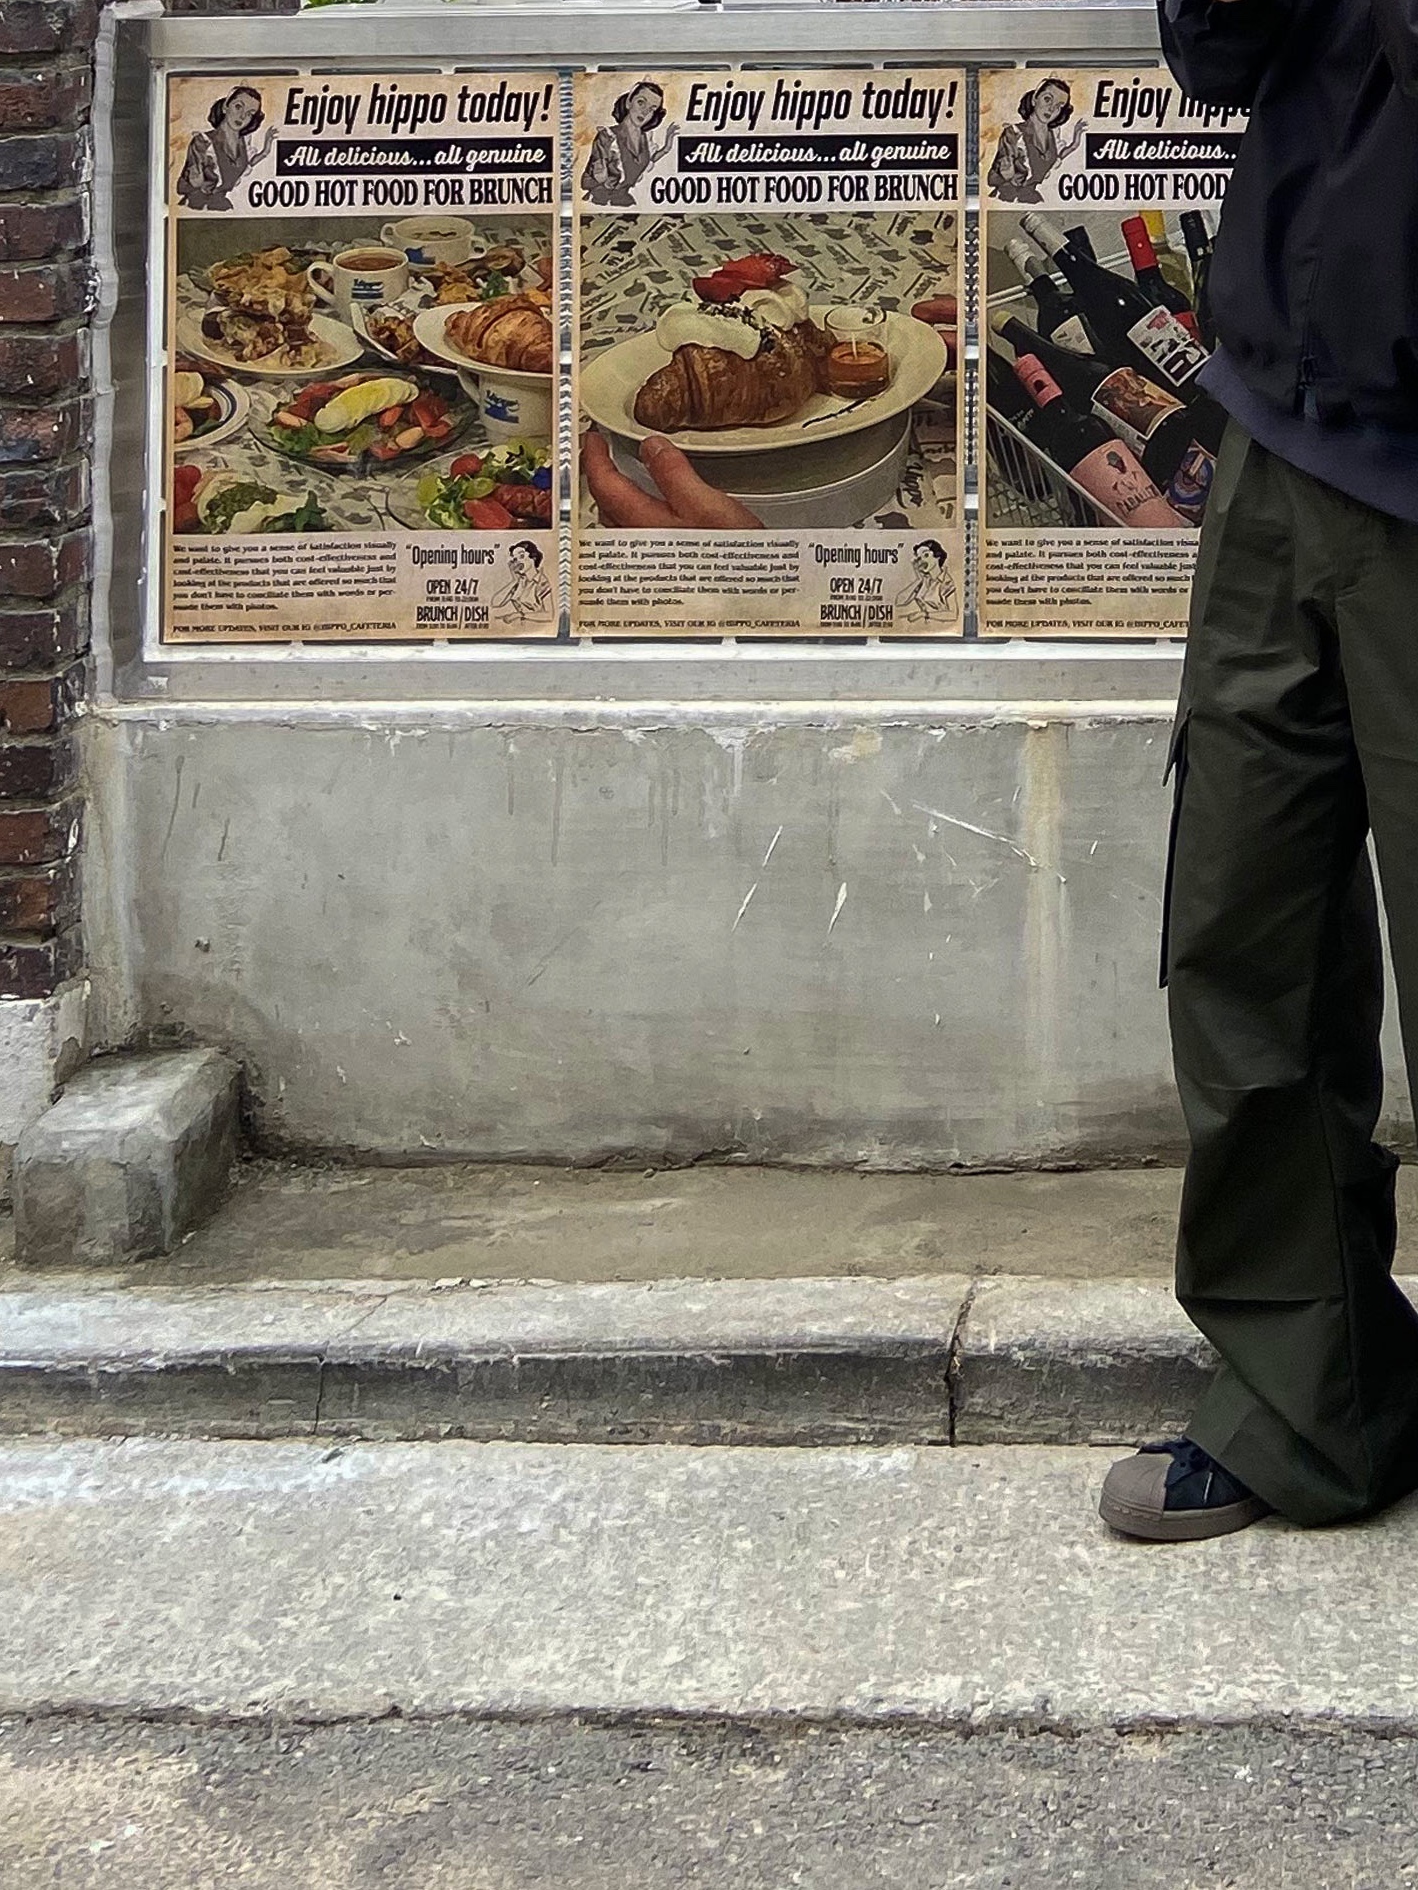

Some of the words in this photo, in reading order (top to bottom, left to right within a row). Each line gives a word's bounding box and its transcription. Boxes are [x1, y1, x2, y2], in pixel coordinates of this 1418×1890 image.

[284, 85, 361, 135] Enjoy
[367, 83, 447, 134] hippo
[458, 81, 553, 132] today!
[686, 81, 765, 131] Enjoy
[771, 79, 852, 130] hippo
[862, 78, 958, 128] today!
[1093, 77, 1172, 128] Enjoy
[284, 146, 321, 166] All
[466, 144, 546, 171] genuine
[685, 143, 723, 163] All
[871, 141, 951, 168] genuine
[1093, 139, 1130, 159] All
[248, 181, 309, 207] GOOD
[315, 180, 358, 206] HOT
[362, 179, 418, 206] FOOD
[423, 179, 464, 206] FOR
[469, 177, 553, 205] BRUNCH
[651, 177, 711, 204] GOOD
[717, 176, 760, 203] HOT
[764, 176, 822, 203] FOOD
[828, 175, 869, 202] FOR
[874, 174, 958, 201] BRUNCH
[1059, 174, 1119, 200] GOOD
[1124, 173, 1168, 200] HOT
[1172, 173, 1228, 200] FOOD
[427, 579, 451, 594] OPEN
[455, 578, 478, 595] 24/7
[830, 578, 854, 593] OPEN
[858, 578, 882, 594] 24/7
